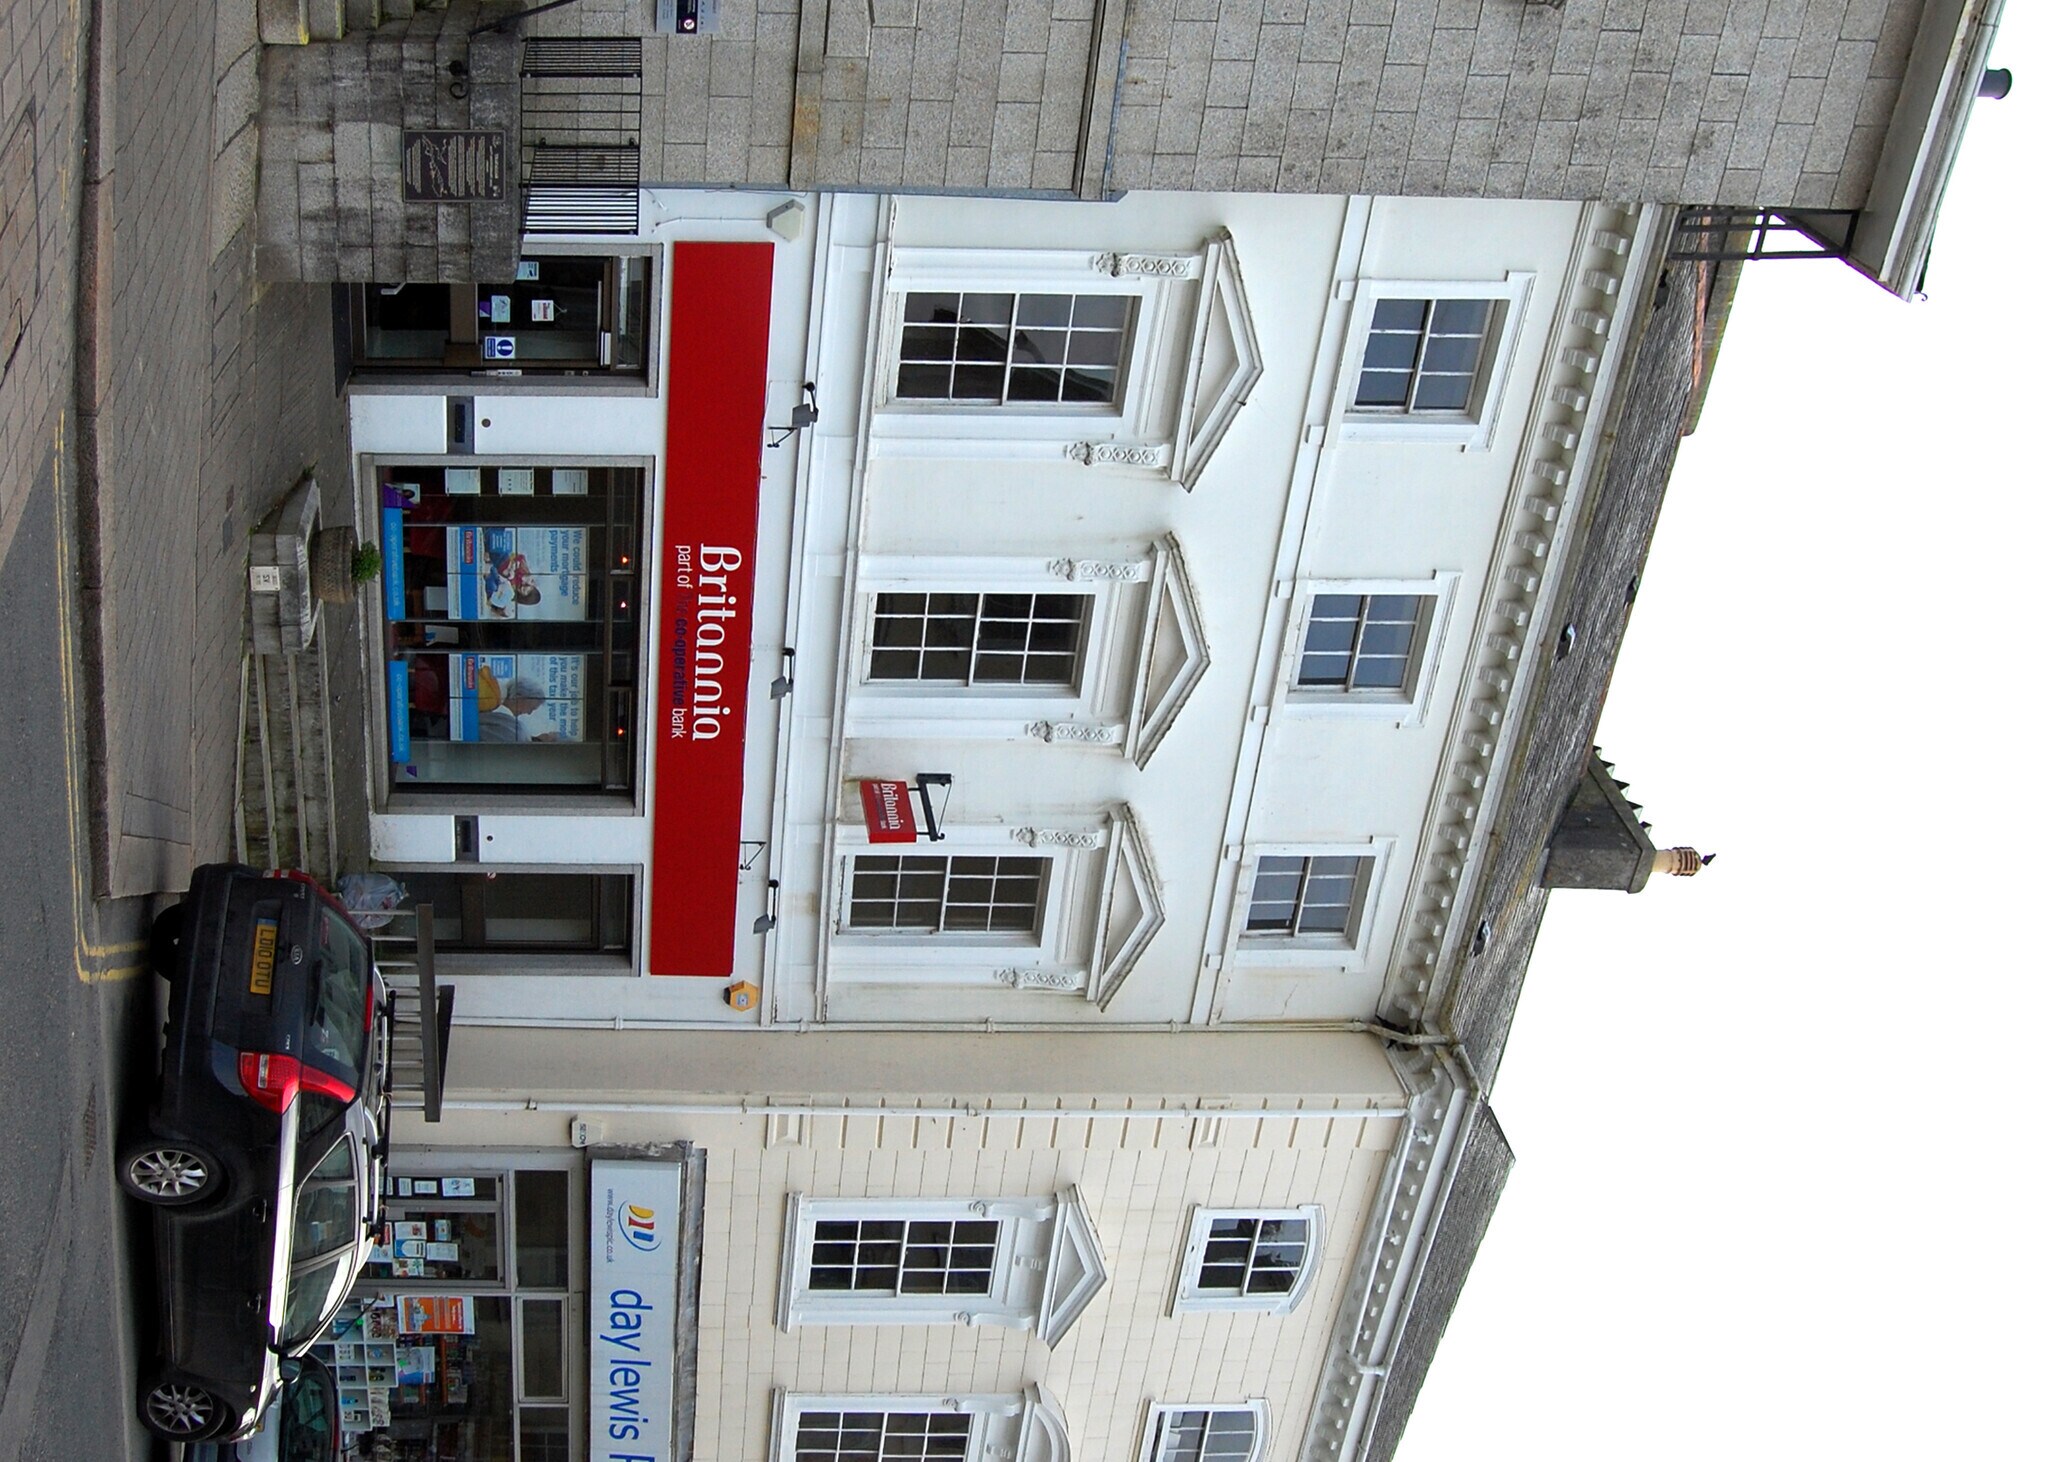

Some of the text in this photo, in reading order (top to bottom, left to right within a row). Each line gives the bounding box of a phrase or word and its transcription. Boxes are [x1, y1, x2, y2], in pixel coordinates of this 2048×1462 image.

[548, 530, 559, 572] payments
[559, 530, 570, 596] your mortgage
[675, 545, 692, 572] part
[572, 530, 582, 606] We could reduce
[677, 575, 692, 589] of
[692, 543, 742, 741] Britannia
[549, 657, 558, 666] of
[549, 667, 558, 682] this
[558, 657, 567, 672] you
[571, 657, 580, 671] It's
[672, 618, 688, 705] co-operative
[560, 674, 568, 698] make
[548, 702, 557, 721] year
[560, 703, 568, 716] the
[570, 708, 578, 716] to
[671, 708, 687, 738] bank
[569, 719, 579, 736] help
[880, 783, 904, 830] Britannia
[255, 929, 274, 989] LD10 OTU
[600, 1290, 653, 1352] day
[609, 1359, 652, 1440] lewis
